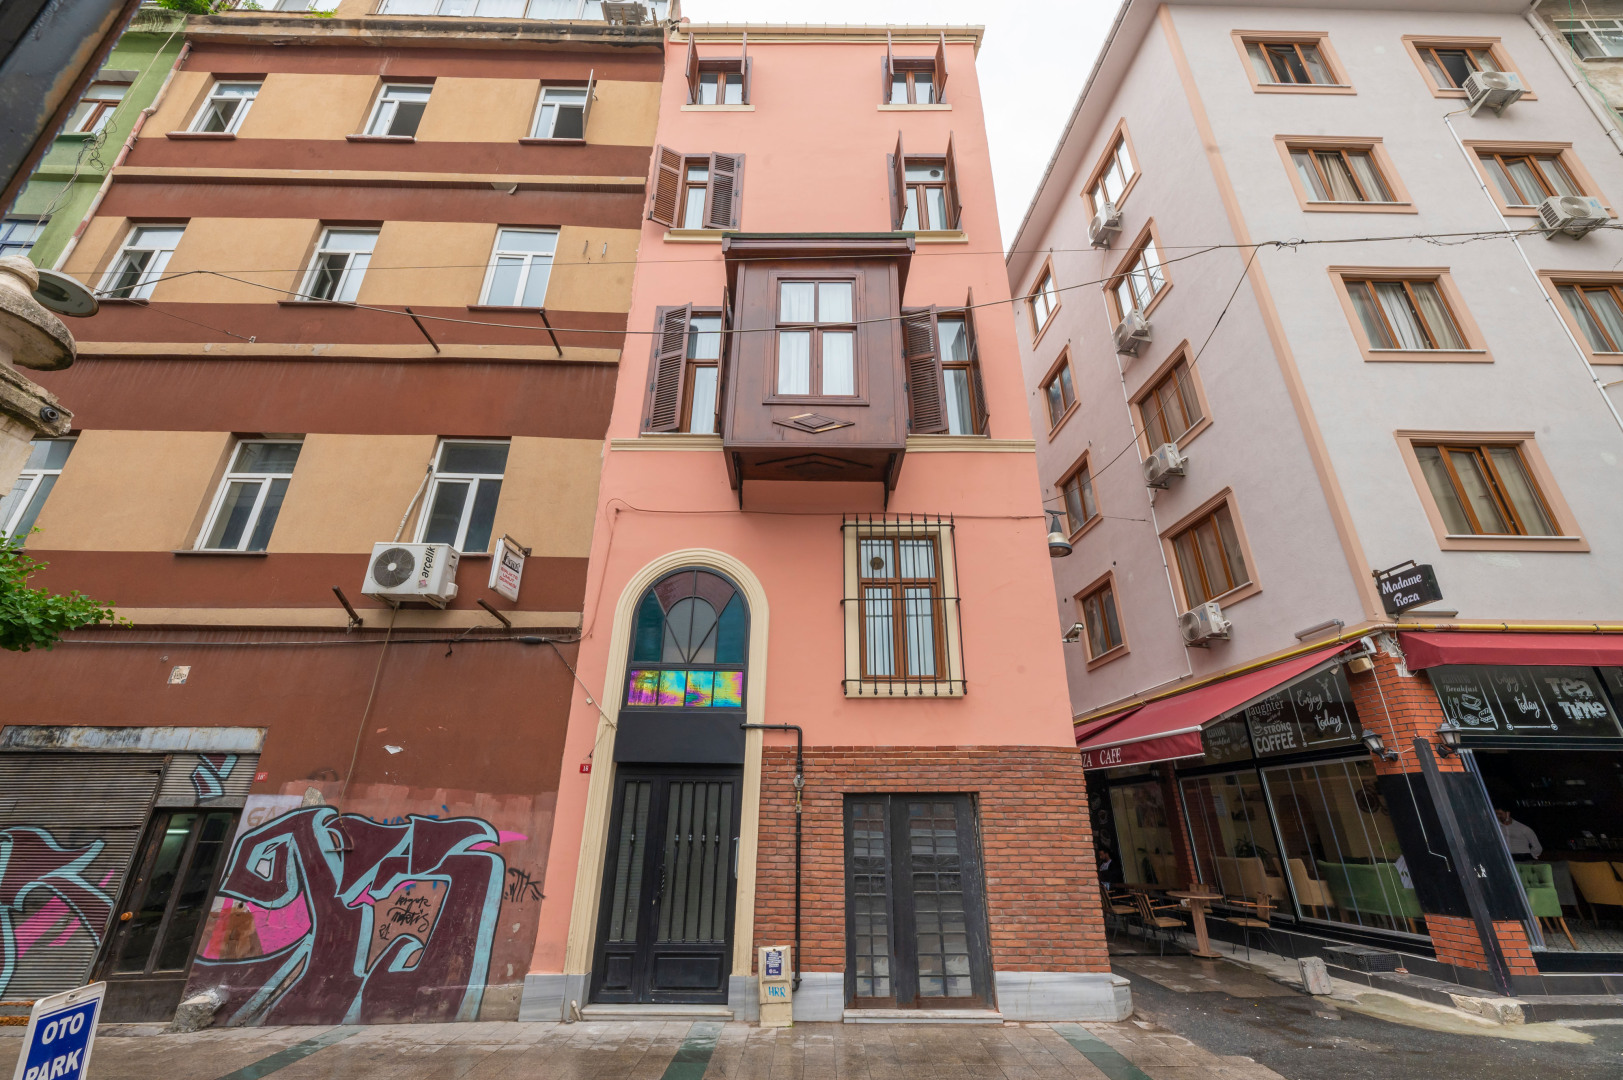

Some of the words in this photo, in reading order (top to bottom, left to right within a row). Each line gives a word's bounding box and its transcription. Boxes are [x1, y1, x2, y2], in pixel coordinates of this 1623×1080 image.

[422, 545, 435, 578] arçelik
[1381, 574, 1423, 595] Madame
[1393, 592, 1420, 607] Roza
[1296, 689, 1324, 712] Enjoy
[1514, 691, 1541, 719] today
[1263, 721, 1292, 736] STRONG
[1314, 708, 1343, 733] today
[1255, 731, 1297, 753] COFFEE
[1082, 752, 1093, 768] ZA
[1100, 747, 1122, 765] CAFE
[41, 1012, 85, 1045] OTO
[25, 1047, 83, 1080] PARK
